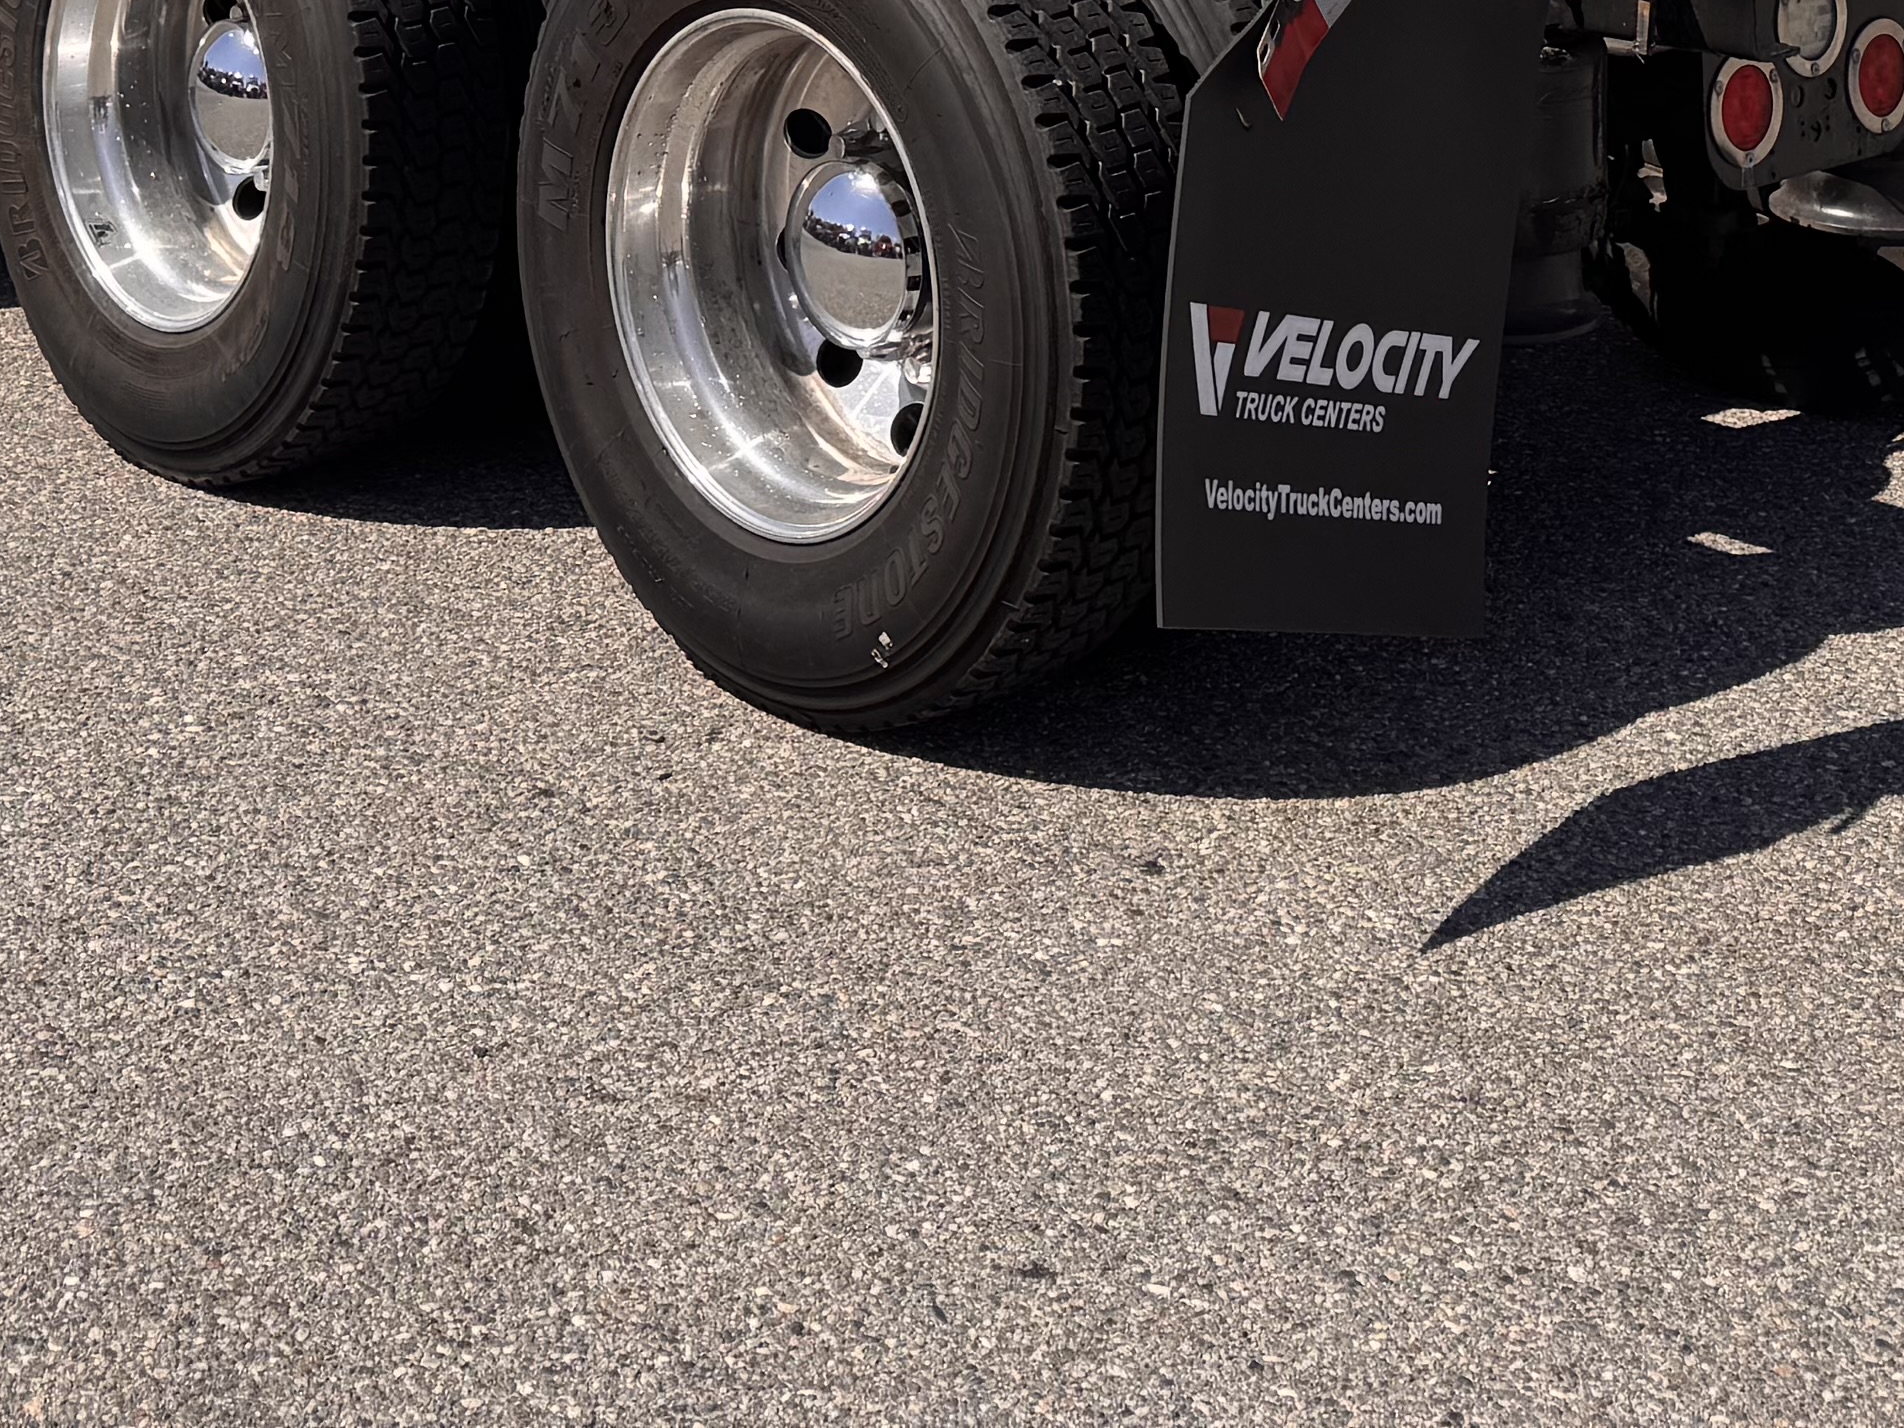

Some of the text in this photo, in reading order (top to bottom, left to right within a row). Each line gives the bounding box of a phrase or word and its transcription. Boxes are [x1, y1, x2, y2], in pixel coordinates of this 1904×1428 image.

[1243, 310, 1480, 400] VELOCITY
[830, 220, 986, 643] BRIDGESTONE
[1234, 390, 1386, 433] TRUCK CENTERS
[1204, 477, 1443, 526] VelocityTruckCenters.com
